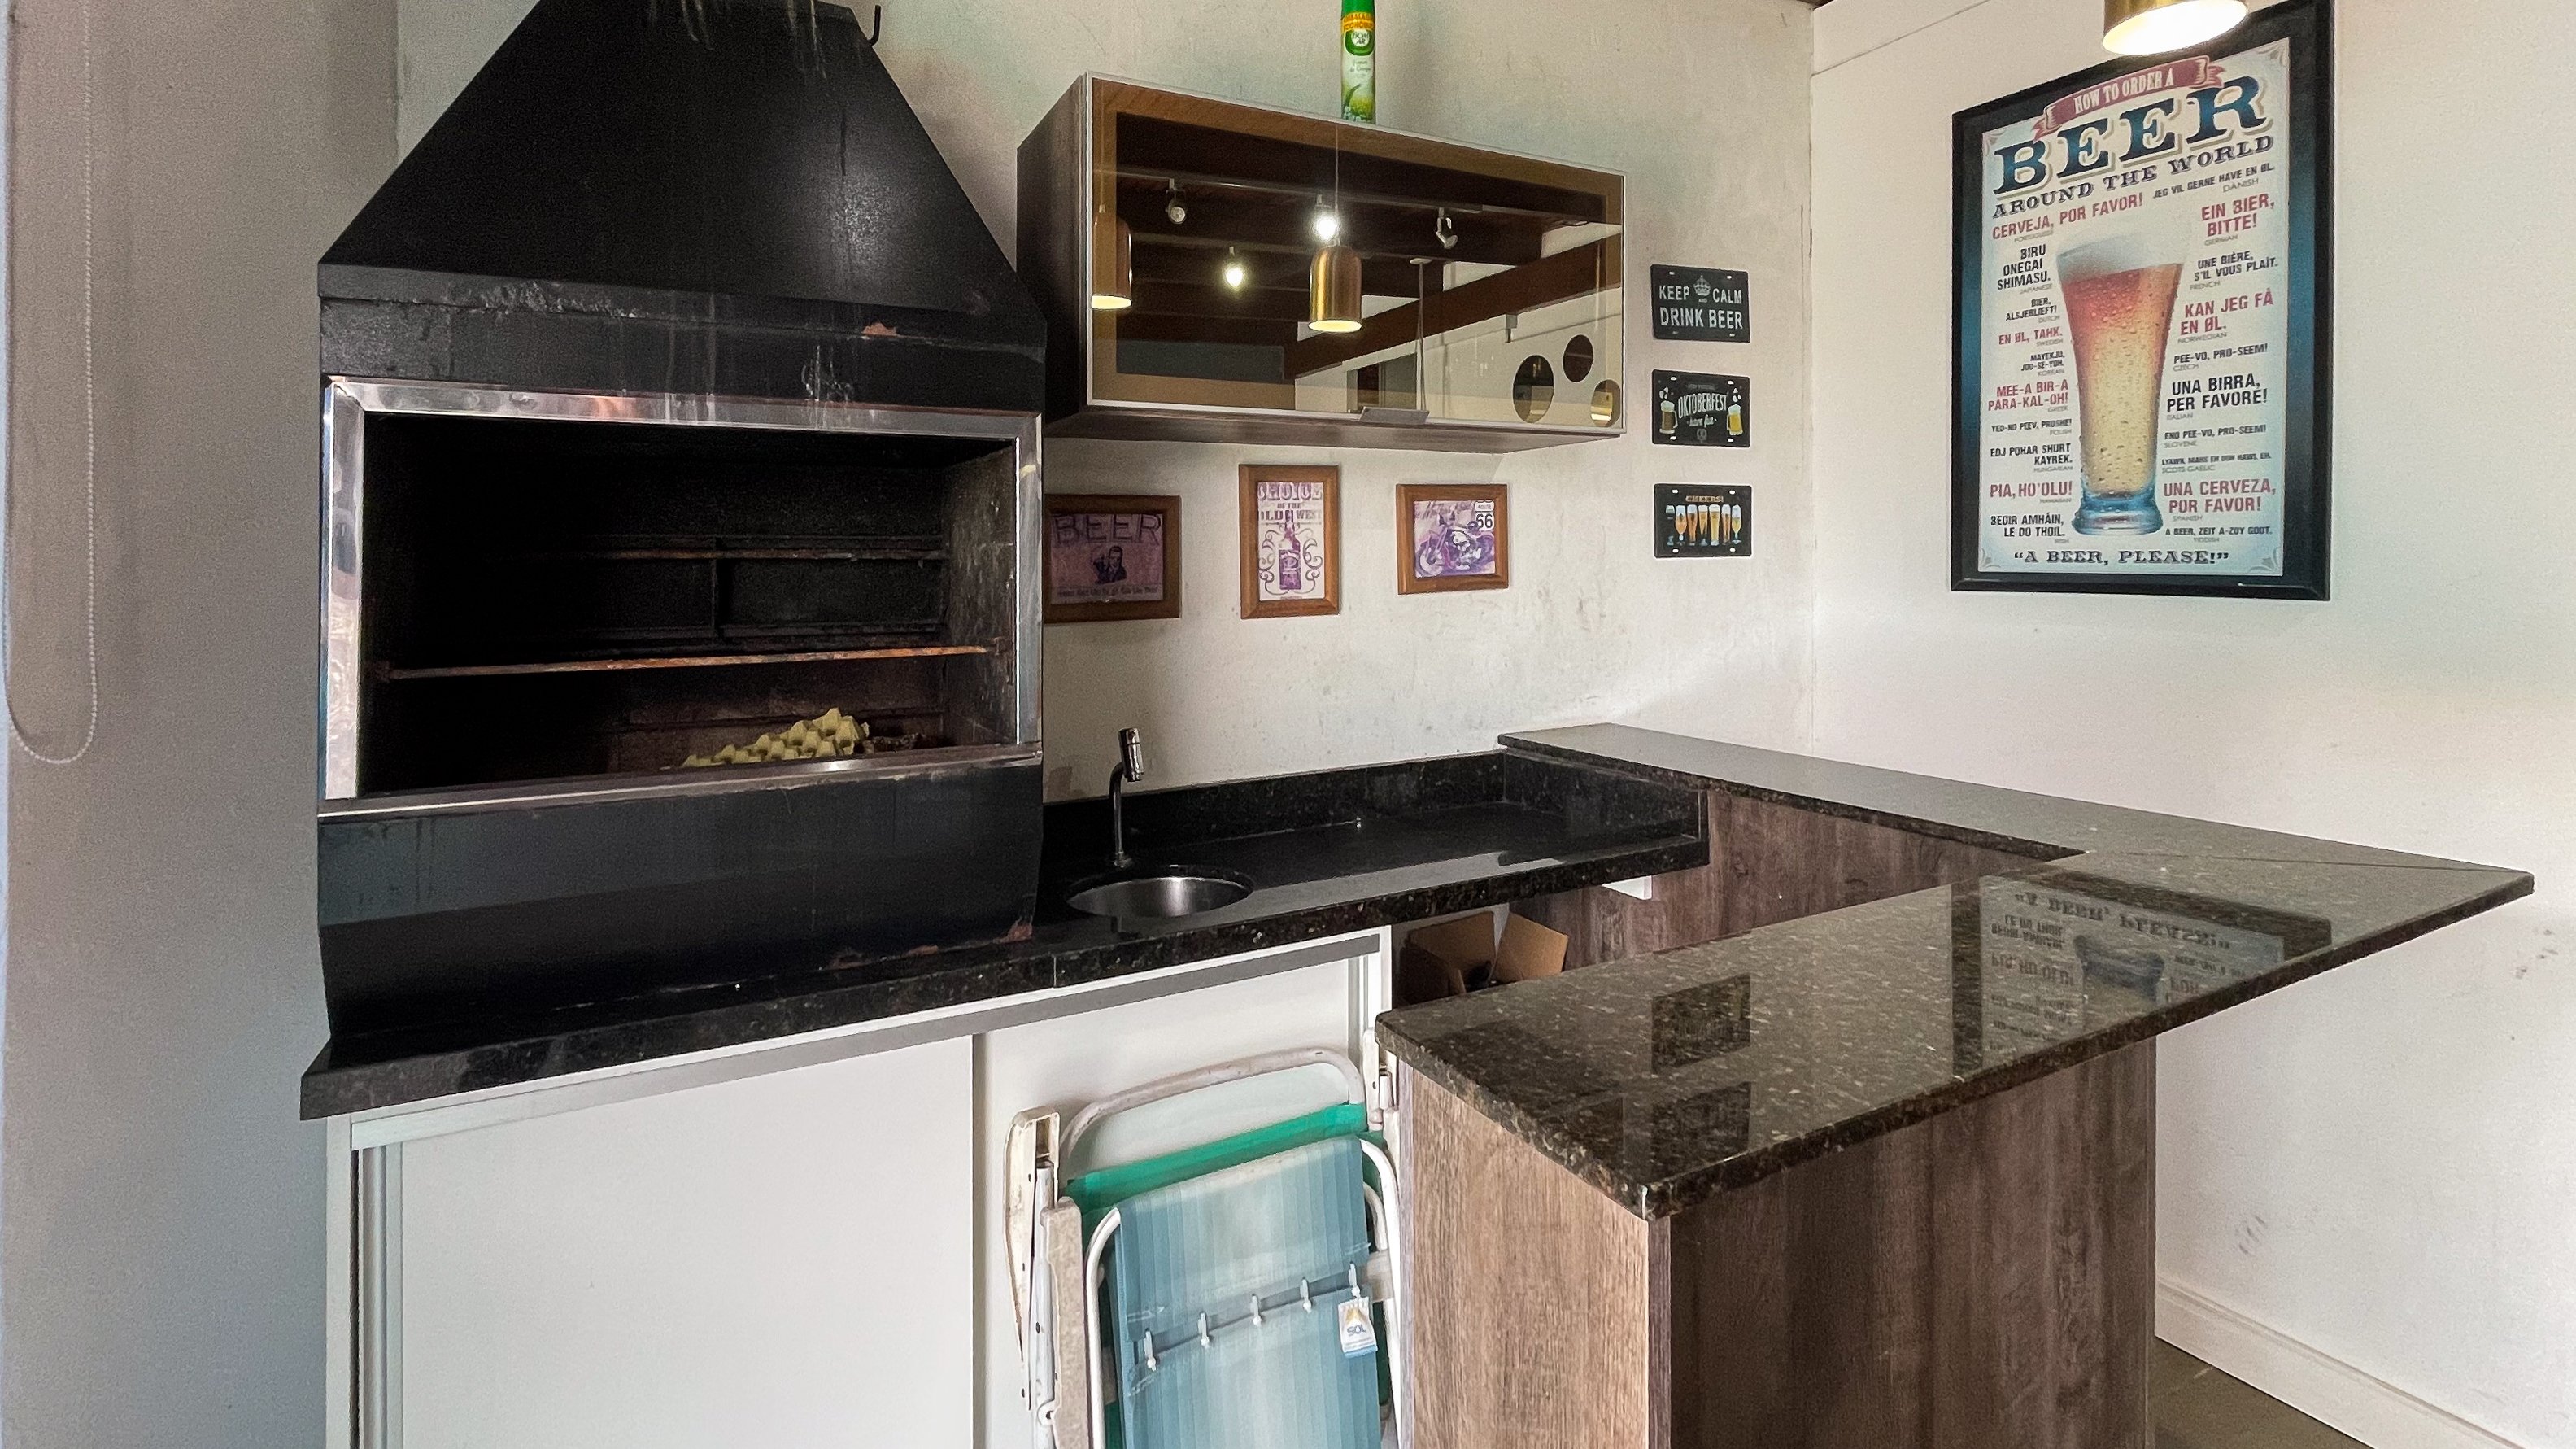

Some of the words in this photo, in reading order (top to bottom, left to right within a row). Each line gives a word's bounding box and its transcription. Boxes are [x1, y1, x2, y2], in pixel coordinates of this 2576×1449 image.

[2074, 89, 2100, 114] HOW
[2103, 83, 2120, 103] TO
[2121, 71, 2163, 97] ORDER
[2164, 68, 2174, 86] A
[1994, 76, 2269, 197] BEER
[1993, 182, 2094, 219] AROUND
[2103, 165, 2157, 191] THE
[2168, 135, 2273, 175] WORLD
[2153, 189, 2168, 199] JEG
[2171, 185, 2185, 194] VIL
[2187, 176, 2216, 190] GERNE
[2219, 170, 2243, 183] HAVE
[2246, 166, 2257, 177] EN
[2223, 178, 2259, 193] DANISH
[1993, 215, 2054, 239] CERVEJA,
[2059, 206, 2086, 225] POR
[2092, 192, 2143, 217] FAVOR!
[2201, 203, 2226, 221] EIN
[2233, 194, 2274, 214] BIER,
[2208, 213, 2257, 238] BITTE!
[2020, 244, 2046, 260] BIRU
[2003, 258, 2042, 277] ONEGAI
[2198, 258, 2216, 269] UNE
[2216, 264, 2242, 277] VOUS
[1997, 271, 2051, 290] SHIMASU.
[2190, 281, 2221, 290] FRENCH
[1659, 285, 1690, 300] KEEP
[1712, 288, 1742, 304] CALM
[2185, 300, 2214, 318] KAN
[2221, 295, 2248, 312] JEG
[2255, 287, 2273, 308] FÅ
[1660, 307, 1704, 327] DRINK
[1709, 309, 1743, 330] BEER
[2181, 320, 2199, 335] EN
[2204, 316, 2226, 332] ØL.
[1998, 334, 2012, 345] EN
[2177, 332, 2227, 343] NORWEGIAN
[2174, 351, 2210, 364] PEE-VO,
[2213, 343, 2268, 359] PRO-SEEM!
[1997, 383, 2032, 397] MEE-A
[2037, 379, 2068, 393] BIR-A
[2172, 379, 2201, 395] UNA
[2208, 373, 2260, 391] BIRRA,
[1678, 393, 1727, 419] OKTOBERFEST
[1988, 392, 2068, 411] PARA-KAL-OH!
[2167, 397, 2195, 412] PER
[2202, 388, 2267, 408] FAVORE!
[2218, 424, 2266, 436] PRO-SEEM!
[1990, 448, 2007, 457] EDJ
[2009, 445, 2038, 456] POHAR
[2042, 443, 2071, 453] SHURT
[2034, 454, 2073, 465] KAYREK.
[1257, 482, 1323, 501] CHOICE
[1990, 483, 2016, 499] PIA,
[2018, 481, 2073, 497] HO'OLU!
[2164, 482, 2193, 496] UNA
[2200, 478, 2276, 495] CERVEZA,
[2168, 499, 2198, 513] POR
[2204, 496, 2261, 513] FAVOR!
[1297, 510, 1323, 520] WEST
[1476, 513, 1493, 529] 66
[1990, 515, 2018, 526] BEOIR
[2021, 511, 2064, 526] AMHÁIN,
[1053, 514, 1161, 545] BEER
[2004, 527, 2015, 537] LE
[2019, 527, 2031, 537] DO
[2035, 526, 2065, 537] THOIL.
[2165, 527, 2171, 535] A
[2173, 527, 2196, 536] BEER,
[2046, 551, 2109, 566] BEER,
[1347, 1324, 1366, 1337] SOL
